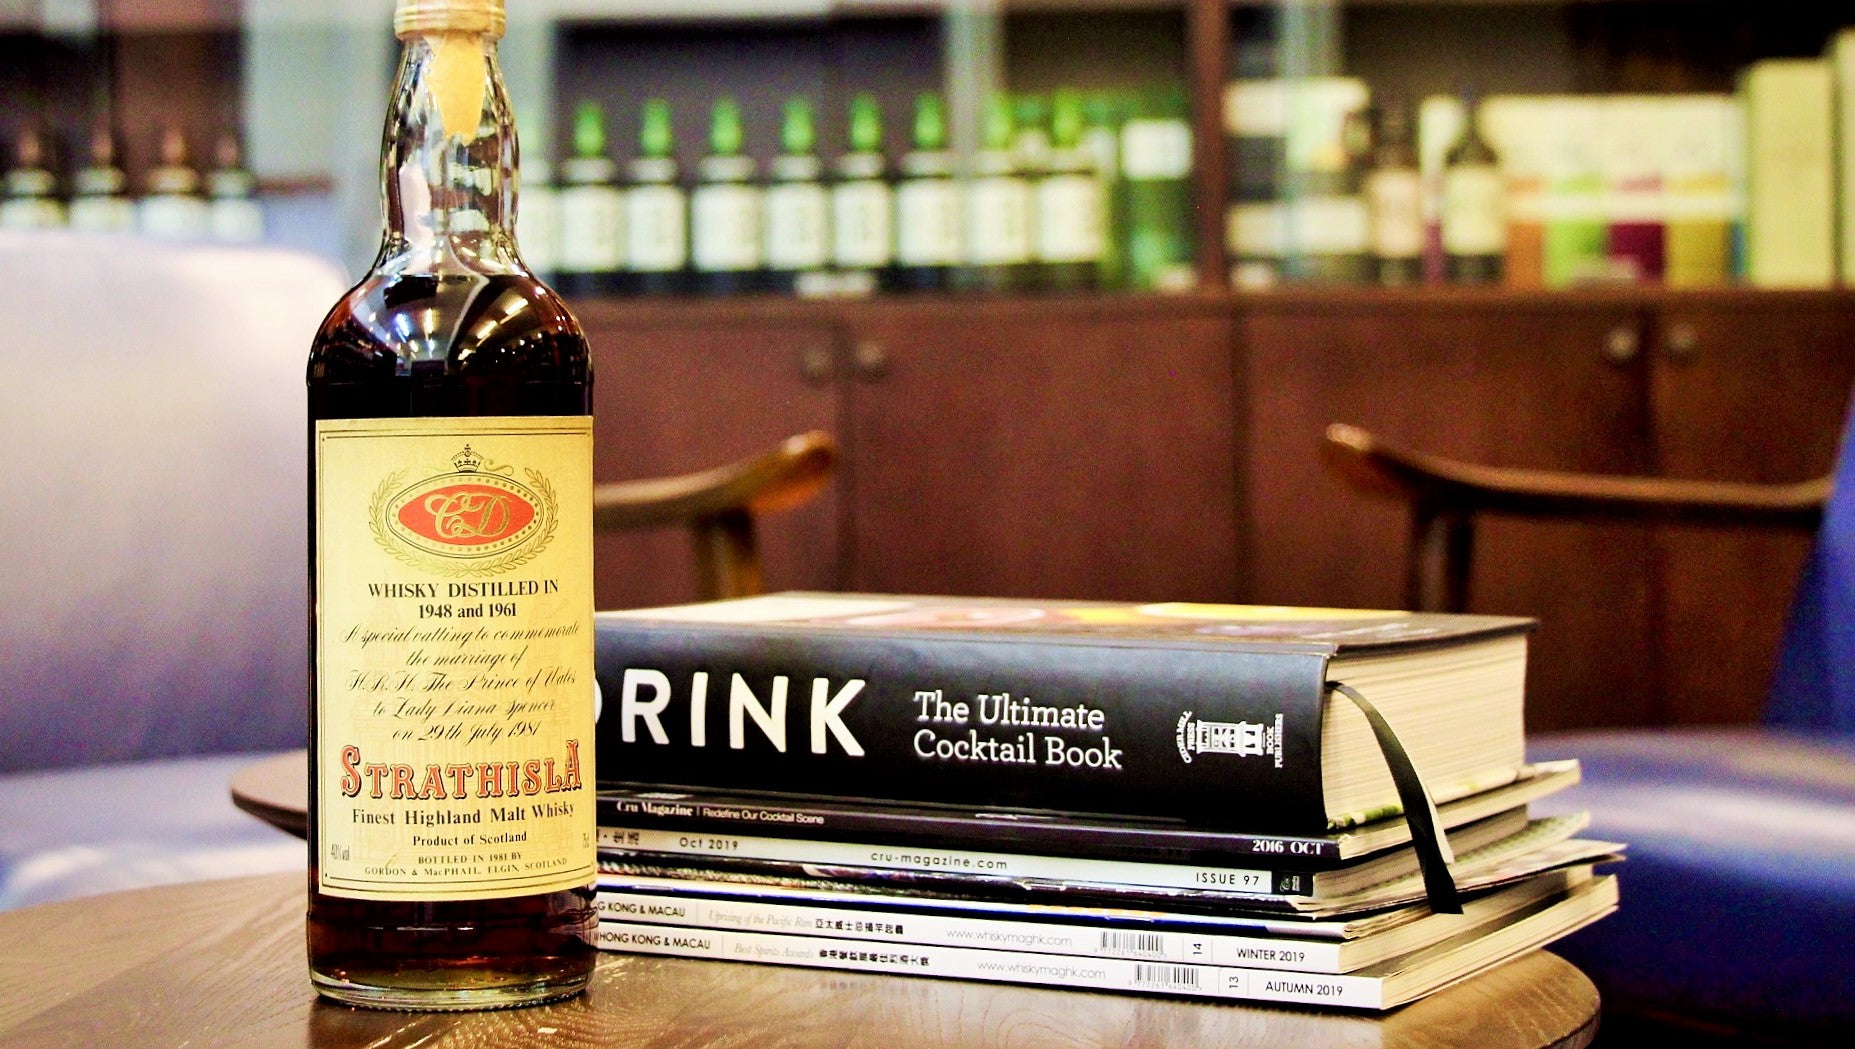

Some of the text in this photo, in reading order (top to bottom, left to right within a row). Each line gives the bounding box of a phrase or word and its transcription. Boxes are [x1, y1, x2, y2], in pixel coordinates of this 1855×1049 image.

[368, 579, 559, 598] WHISKY DISTILLED IN
[418, 602, 517, 618] 1948 and 1961
[361, 626, 411, 649] special
[413, 627, 478, 649] vatting
[473, 626, 490, 642] to
[494, 622, 580, 642] commemorate
[406, 645, 527, 670] the marriage of
[418, 668, 454, 692] The
[459, 668, 520, 692] Prince
[525, 664, 541, 691] of
[544, 659, 577, 686] Wales
[372, 702, 386, 716] to
[393, 697, 438, 724] Lady
[441, 698, 497, 716] Diana
[914, 690, 1106, 729] The Ultimate
[392, 721, 541, 746] on 29th July 1981
[914, 728, 1123, 771] Cocktail Book
[340, 738, 583, 800] STRATHISLA
[352, 801, 575, 826] Finest Highland Malt Whisky
[616, 801, 825, 825] Cru Magazine Redefine Our Cocktail Scene
[412, 831, 527, 847] Product of Scotland
[679, 837, 739, 850] Oct 2019
[1252, 839, 1324, 856] 2016 OCT
[364, 866, 407, 876] GORDON
[411, 868, 418, 876] &
[524, 857, 568, 870] SCOTLAND
[418, 852, 522, 865] BOTTLED IN 1981 BY
[871, 852, 1008, 870] cru-magazine.com
[1196, 872, 1260, 886] ISSUE 97
[608, 903, 637, 914] KONG
[640, 905, 646, 914] &
[648, 906, 686, 917] MACAU
[600, 932, 711, 949] HONG KONG & MACAU
[946, 929, 1073, 948] www.whiskymaghk.com
[1193, 943, 1202, 955] 14
[1237, 948, 1305, 963] WINTER 2019
[978, 960, 1106, 980] www.whiskymaghk.com
[1229, 976, 1239, 989] 13
[1265, 982, 1343, 997] AUTUMN 2019
